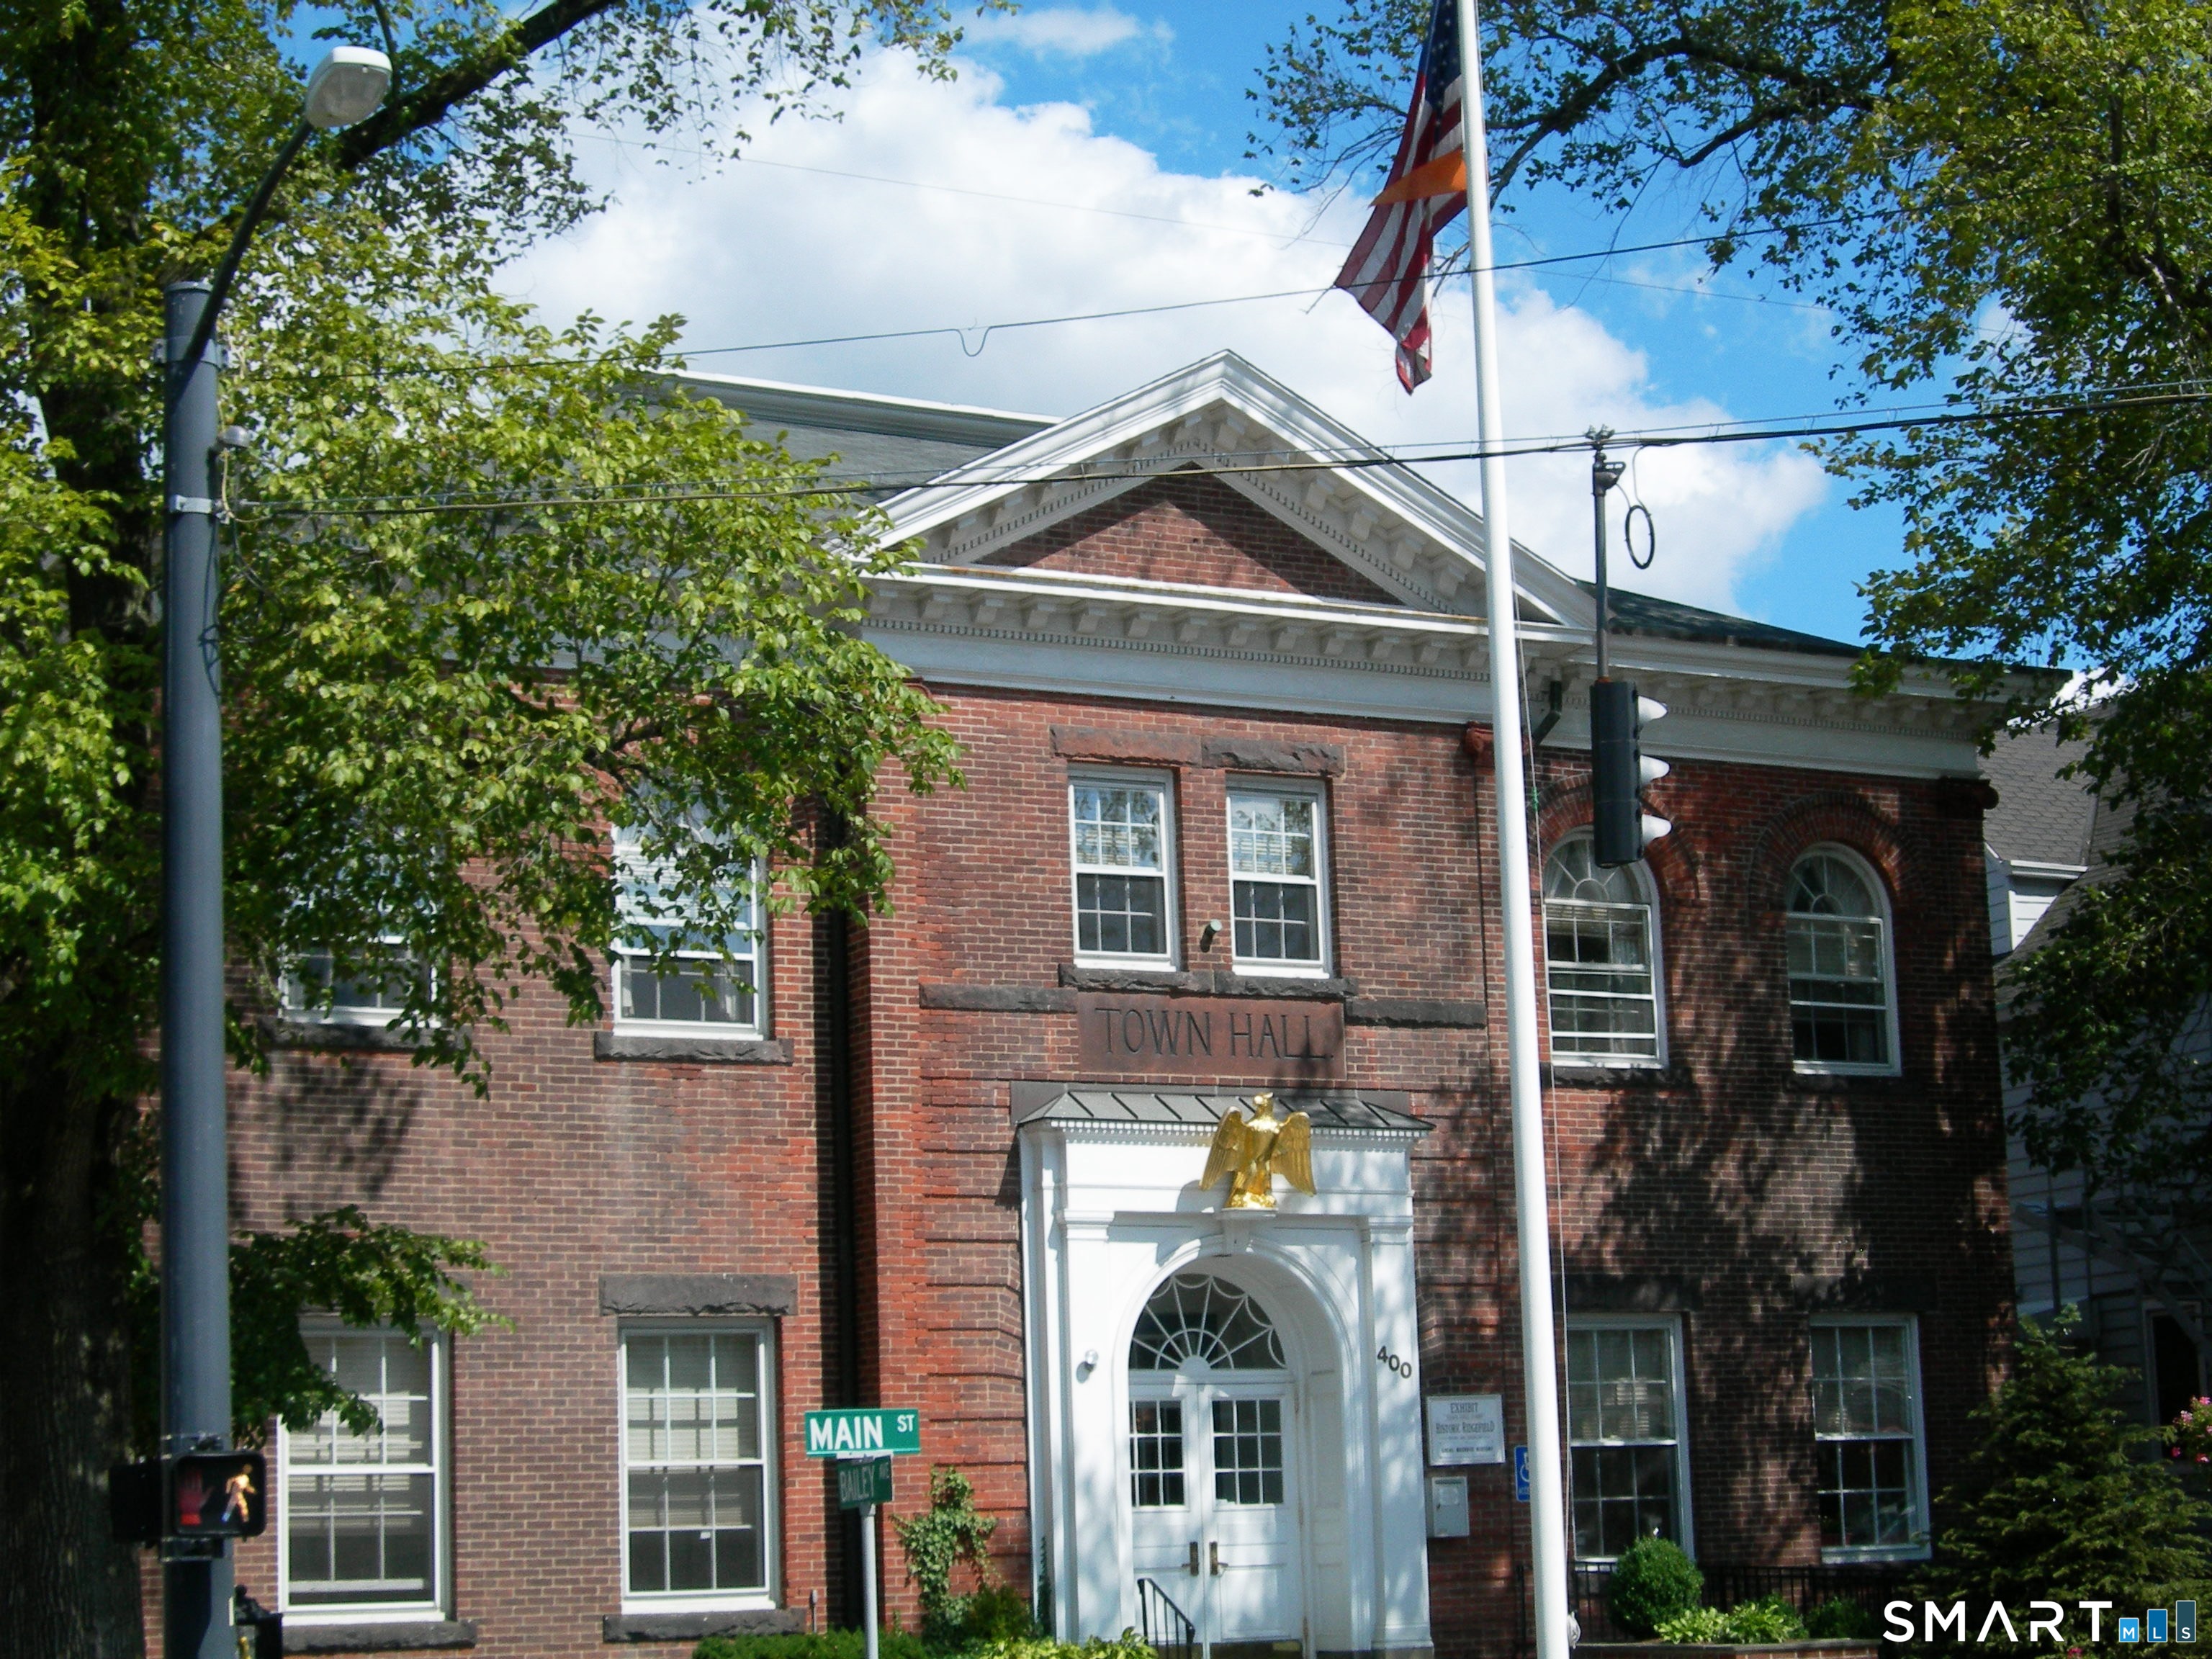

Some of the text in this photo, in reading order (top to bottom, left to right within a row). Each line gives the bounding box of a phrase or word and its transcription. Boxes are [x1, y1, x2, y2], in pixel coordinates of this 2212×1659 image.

[1095, 1008, 1212, 1057] TOWN
[1377, 1345, 1413, 1379] 400
[1450, 1402, 1478, 1413] EXHIBIT
[809, 1414, 915, 1451] MAIN ST
[1462, 1420, 1495, 1433] RIDGEFIELD
[839, 1465, 875, 1503] BAILEY
